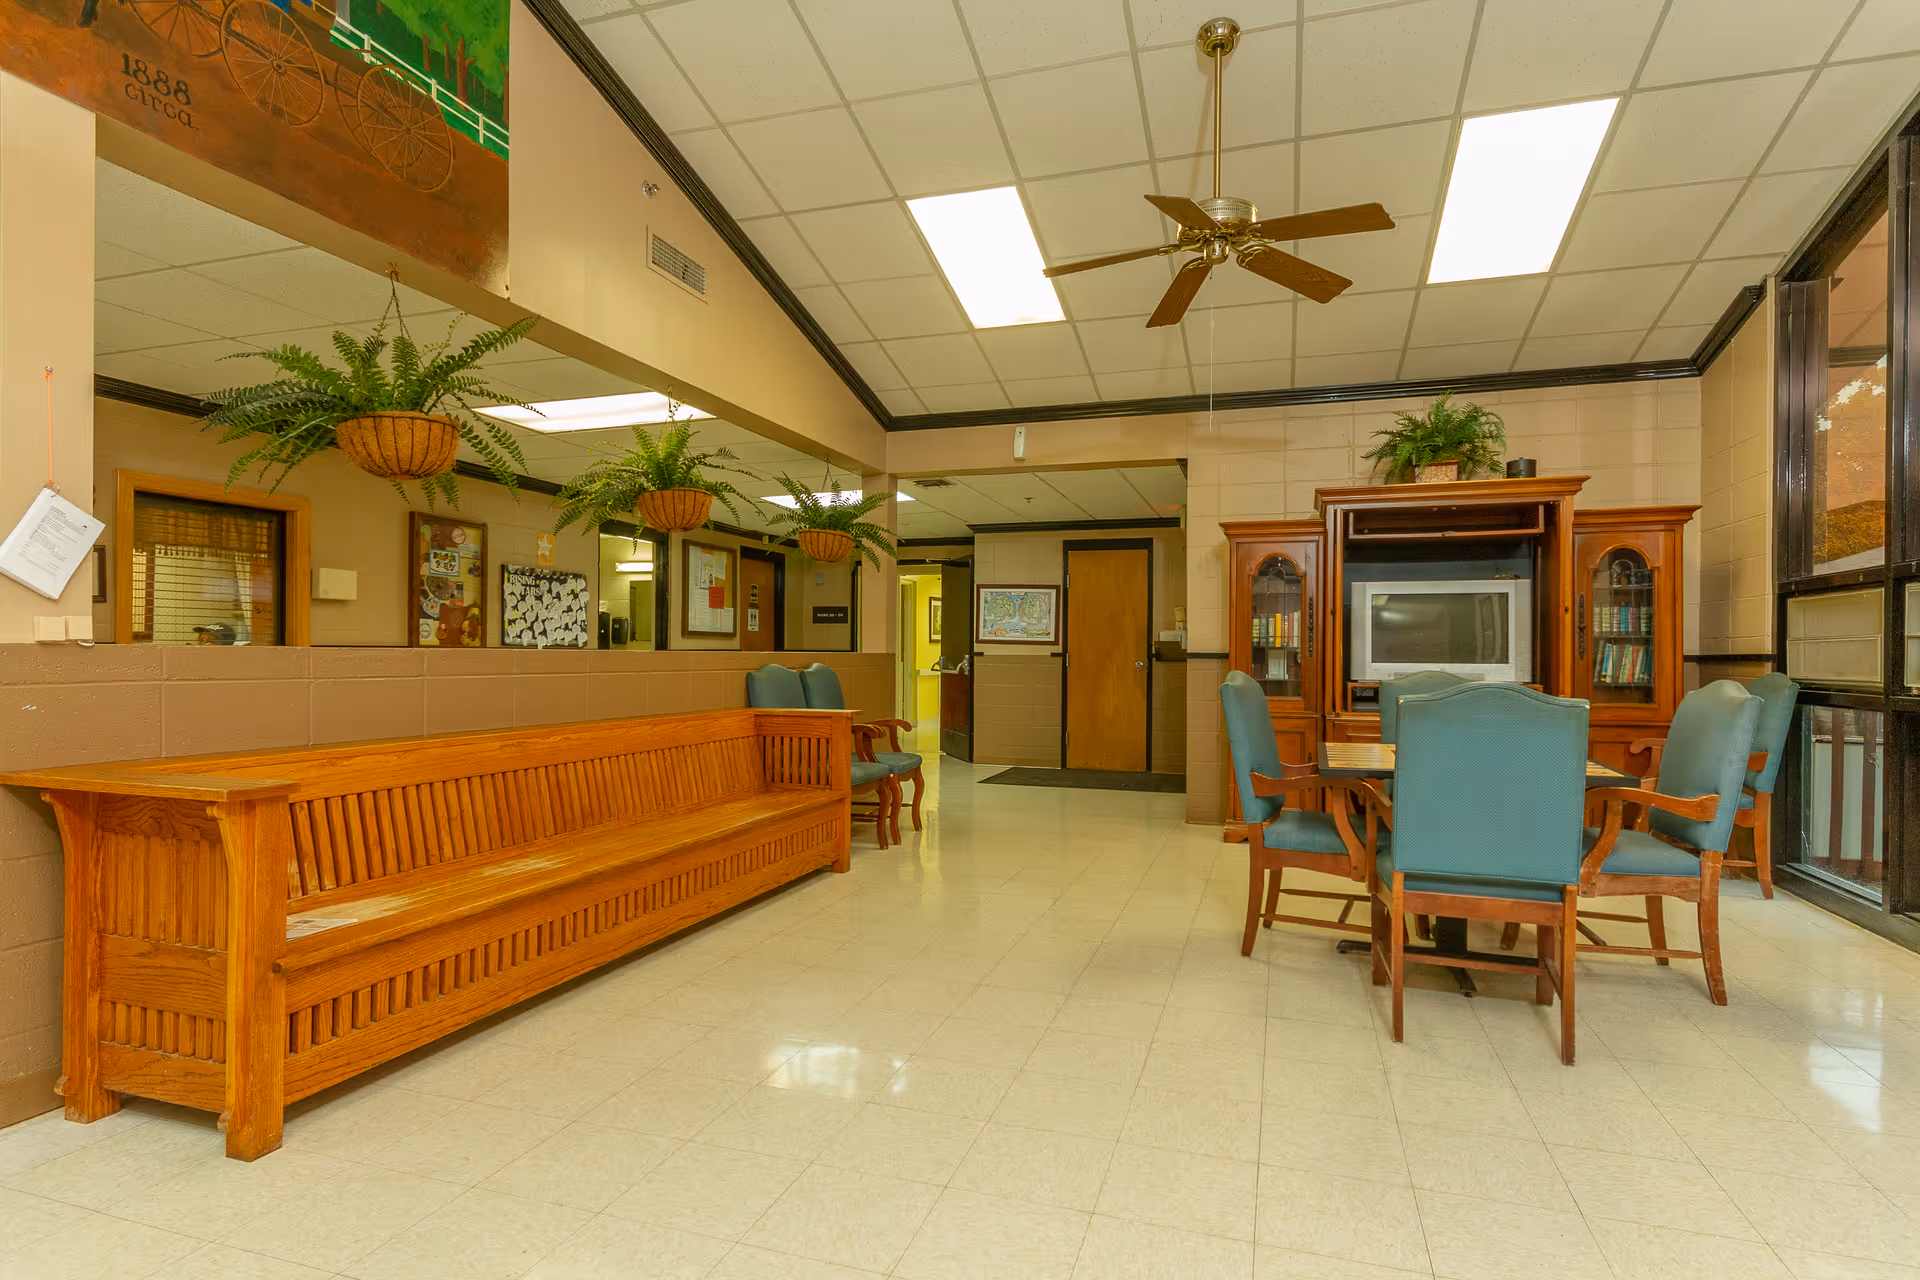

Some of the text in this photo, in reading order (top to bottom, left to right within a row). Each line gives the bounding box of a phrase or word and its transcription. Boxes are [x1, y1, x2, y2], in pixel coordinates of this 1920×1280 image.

[121, 52, 191, 105] 1888
[509, 574, 536, 585] RISING
[520, 585, 541, 596] TARS
